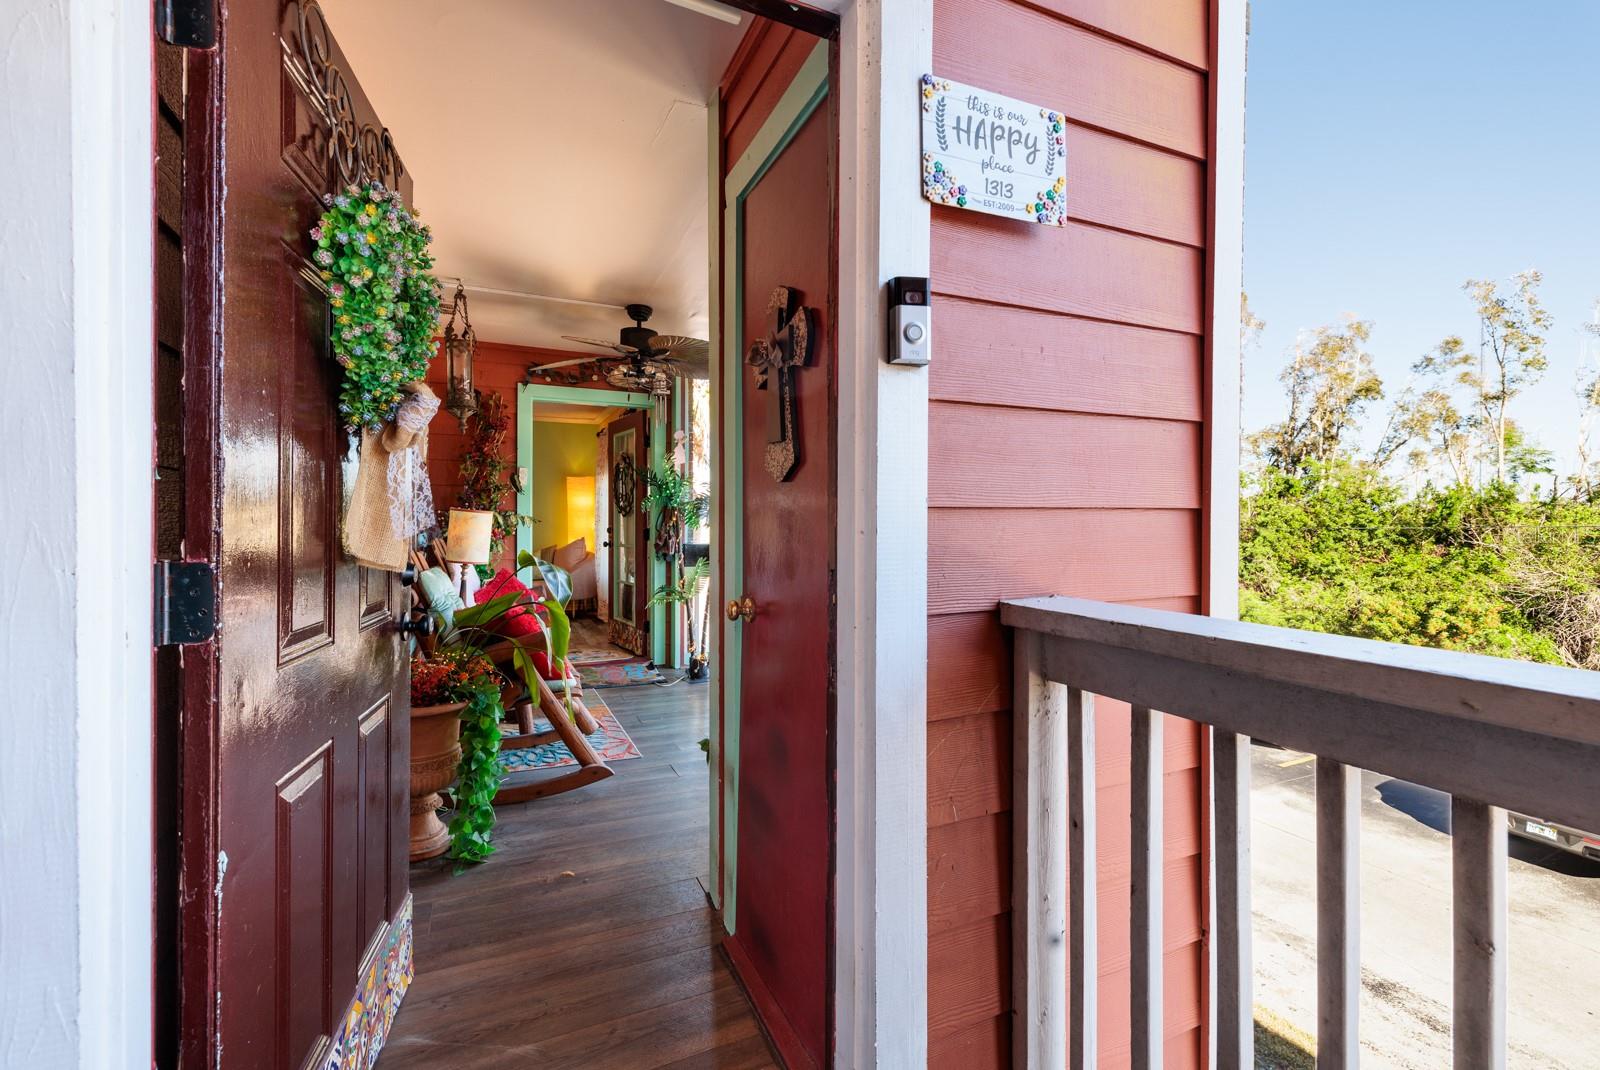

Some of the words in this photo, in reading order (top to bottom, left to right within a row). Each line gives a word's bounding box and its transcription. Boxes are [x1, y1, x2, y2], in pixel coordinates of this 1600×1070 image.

[966, 95, 991, 117] this
[993, 106, 1005, 120] is
[1007, 111, 1028, 126] our
[981, 155, 1014, 174] place
[985, 177, 1014, 199] 1313
